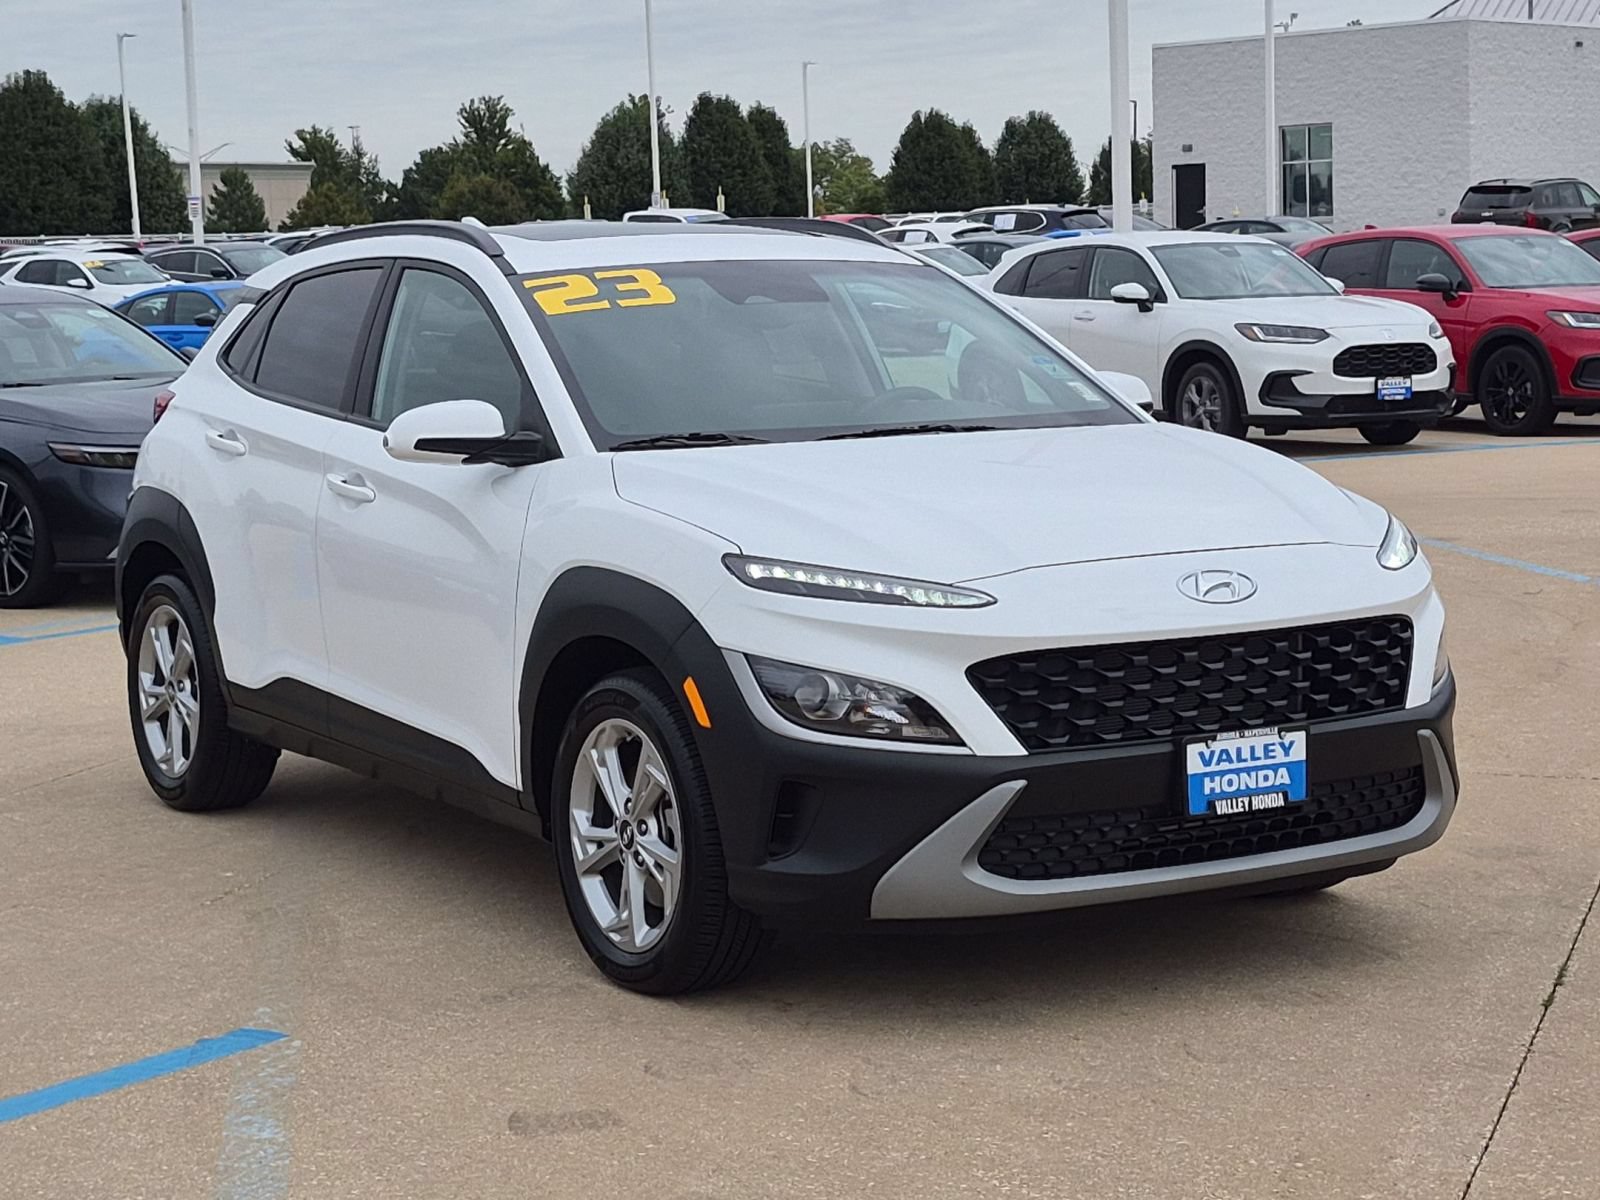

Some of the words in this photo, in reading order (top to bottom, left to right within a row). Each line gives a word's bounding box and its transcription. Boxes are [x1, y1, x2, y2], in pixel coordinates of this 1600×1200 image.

[522, 268, 676, 315] 23
[1198, 740, 1295, 768] VALLEY
[1204, 767, 1291, 795] HONDA
[1215, 796, 1250, 815] VALLEY
[1252, 792, 1285, 811] HONDA
